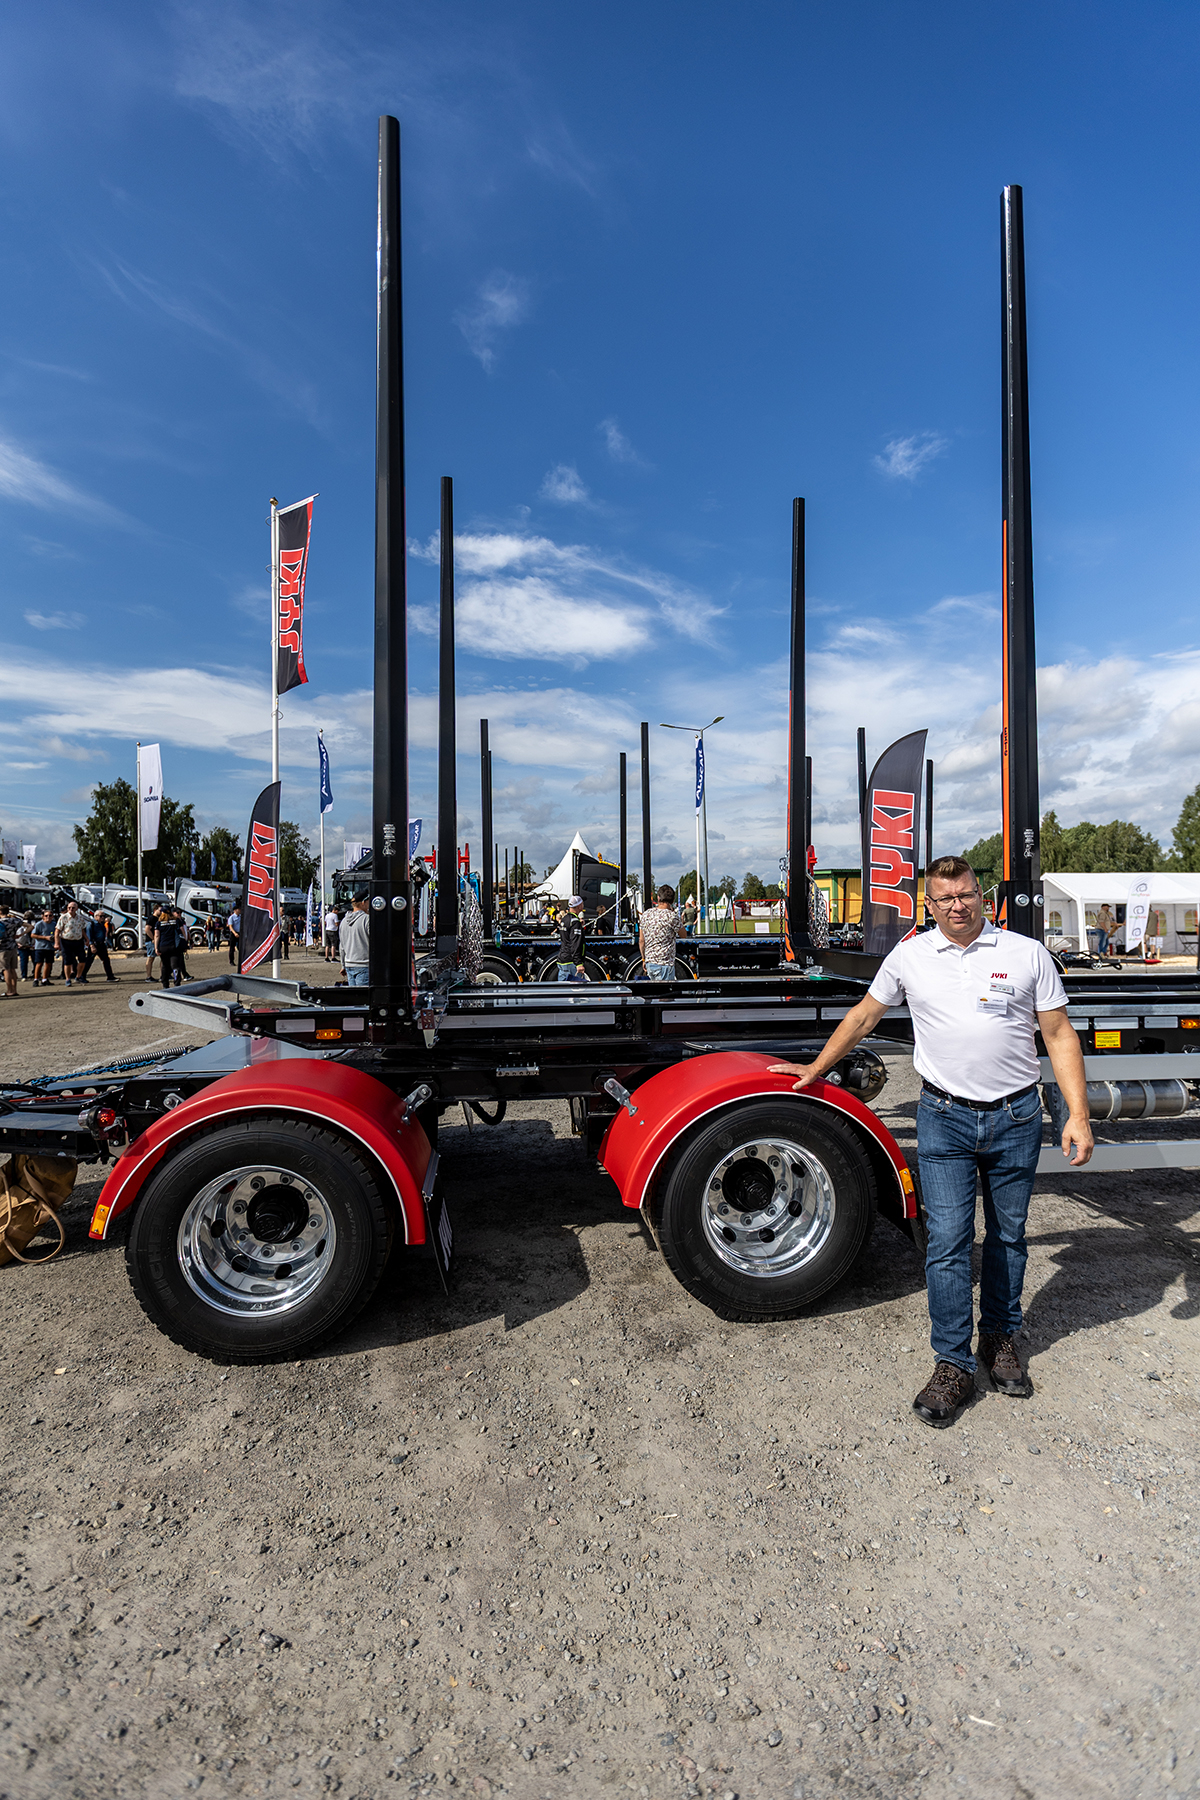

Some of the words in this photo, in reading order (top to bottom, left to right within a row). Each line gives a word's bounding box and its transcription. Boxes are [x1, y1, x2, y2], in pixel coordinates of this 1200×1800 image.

[279, 547, 305, 654] JYKI
[696, 749, 704, 800] ALUCAR
[248, 821, 277, 920] JYKI
[869, 788, 915, 919] JYKI
